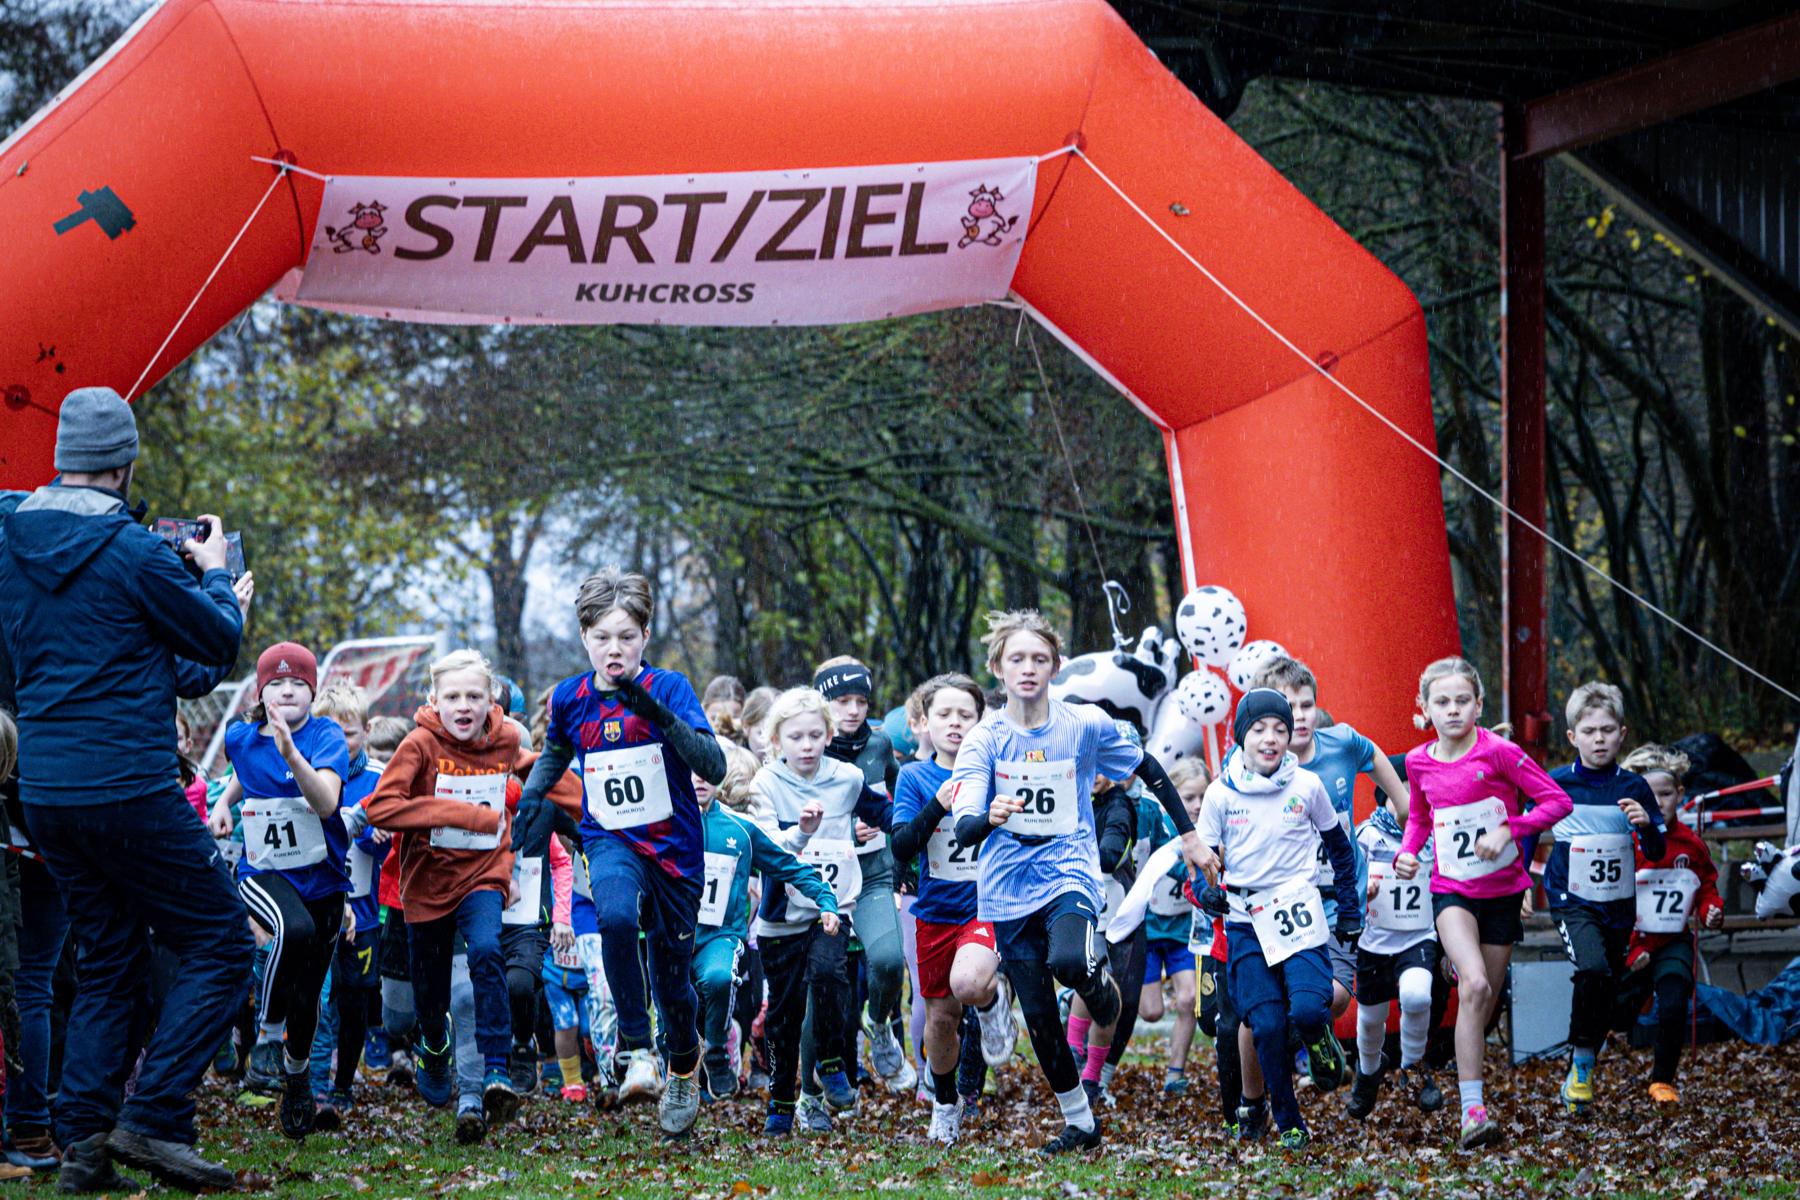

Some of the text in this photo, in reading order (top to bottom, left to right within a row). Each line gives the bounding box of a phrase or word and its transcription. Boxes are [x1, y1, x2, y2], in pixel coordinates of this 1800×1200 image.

[394, 182, 949, 265] START/ZIEL
[574, 282, 756, 304] KUHCROSS
[604, 775, 645, 807] 60
[1015, 788, 1055, 815] 26
[264, 820, 297, 849] 41
[1590, 859, 1621, 883] 35
[1390, 886, 1421, 910] 12
[1653, 891, 1684, 914] 72
[1274, 902, 1313, 937] 36
[358, 946, 372, 976] 7
